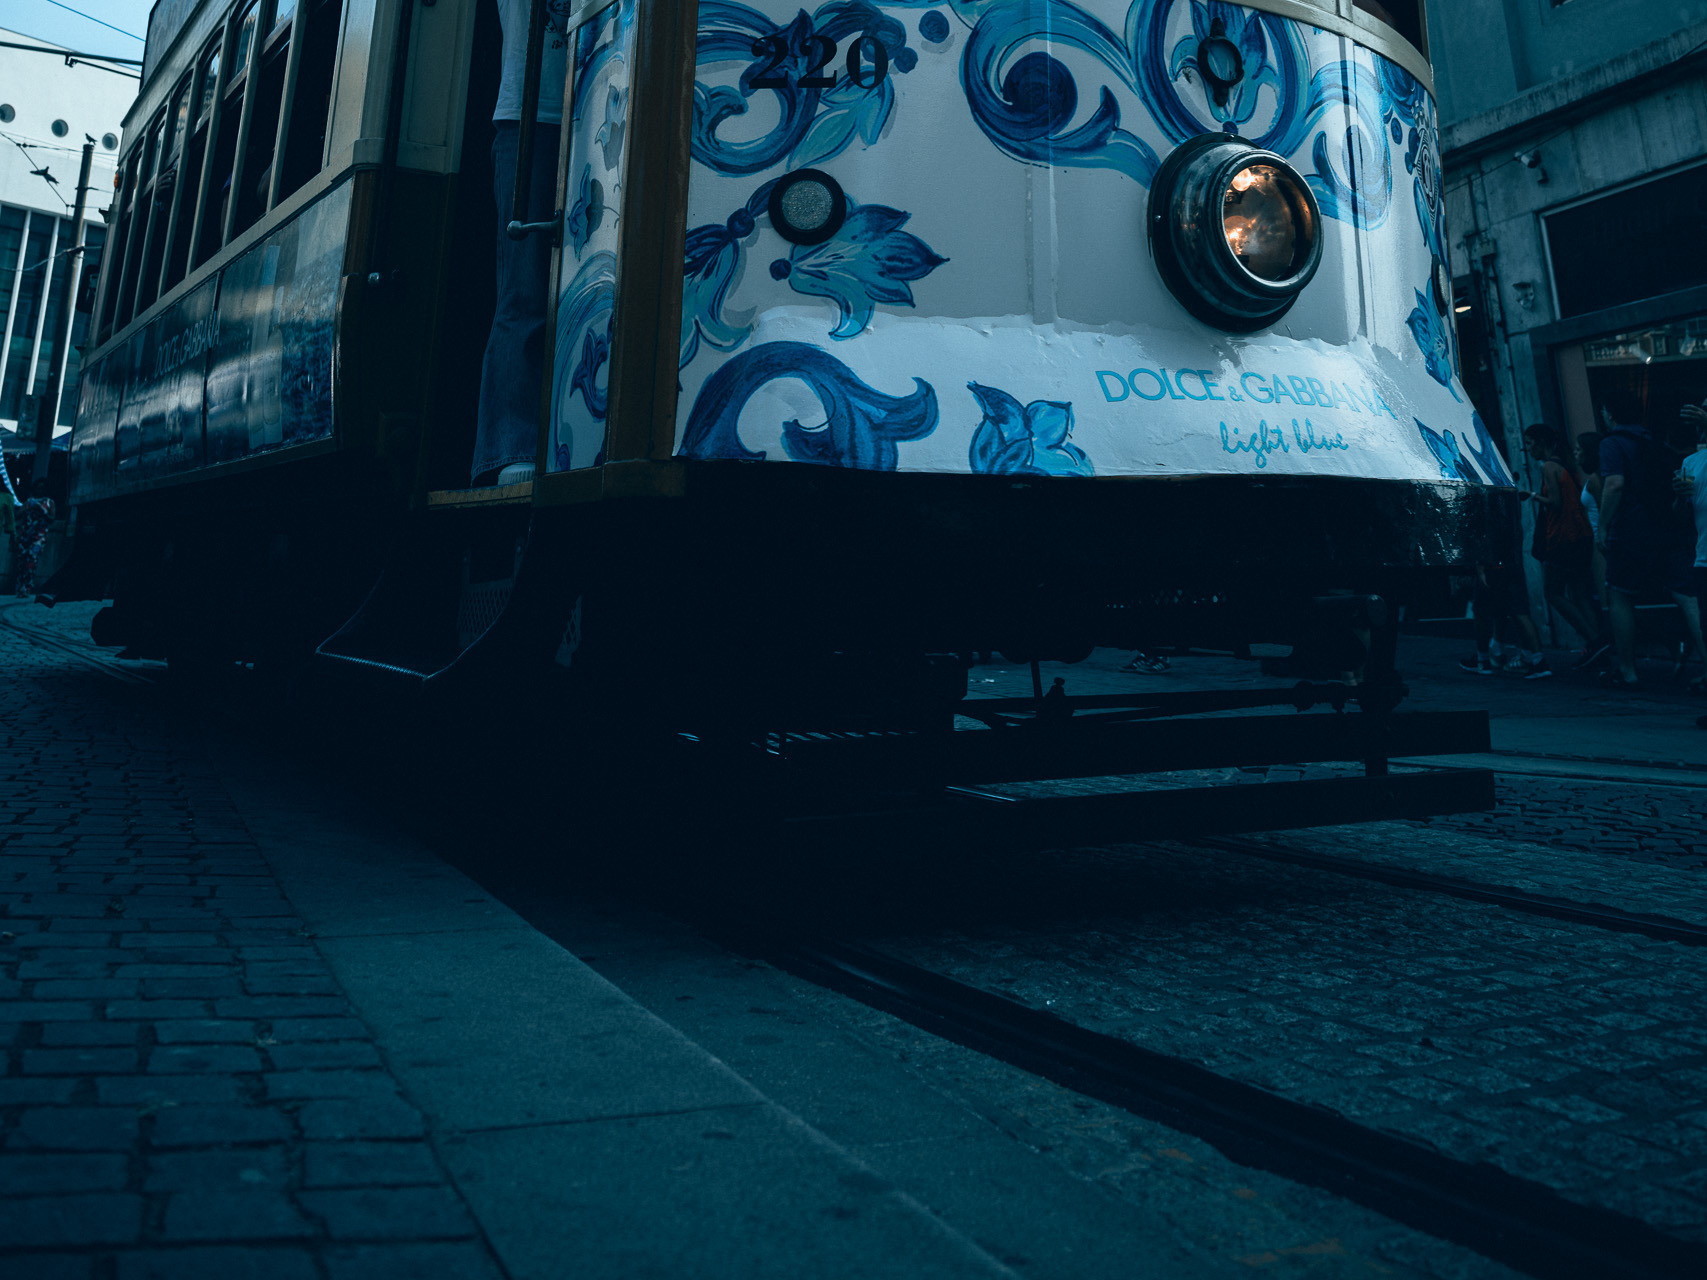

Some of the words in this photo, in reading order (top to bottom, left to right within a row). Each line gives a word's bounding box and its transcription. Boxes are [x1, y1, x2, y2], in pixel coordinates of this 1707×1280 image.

[749, 35, 889, 90] 220
[1219, 419, 1290, 468] light
[1292, 418, 1349, 453] blue
